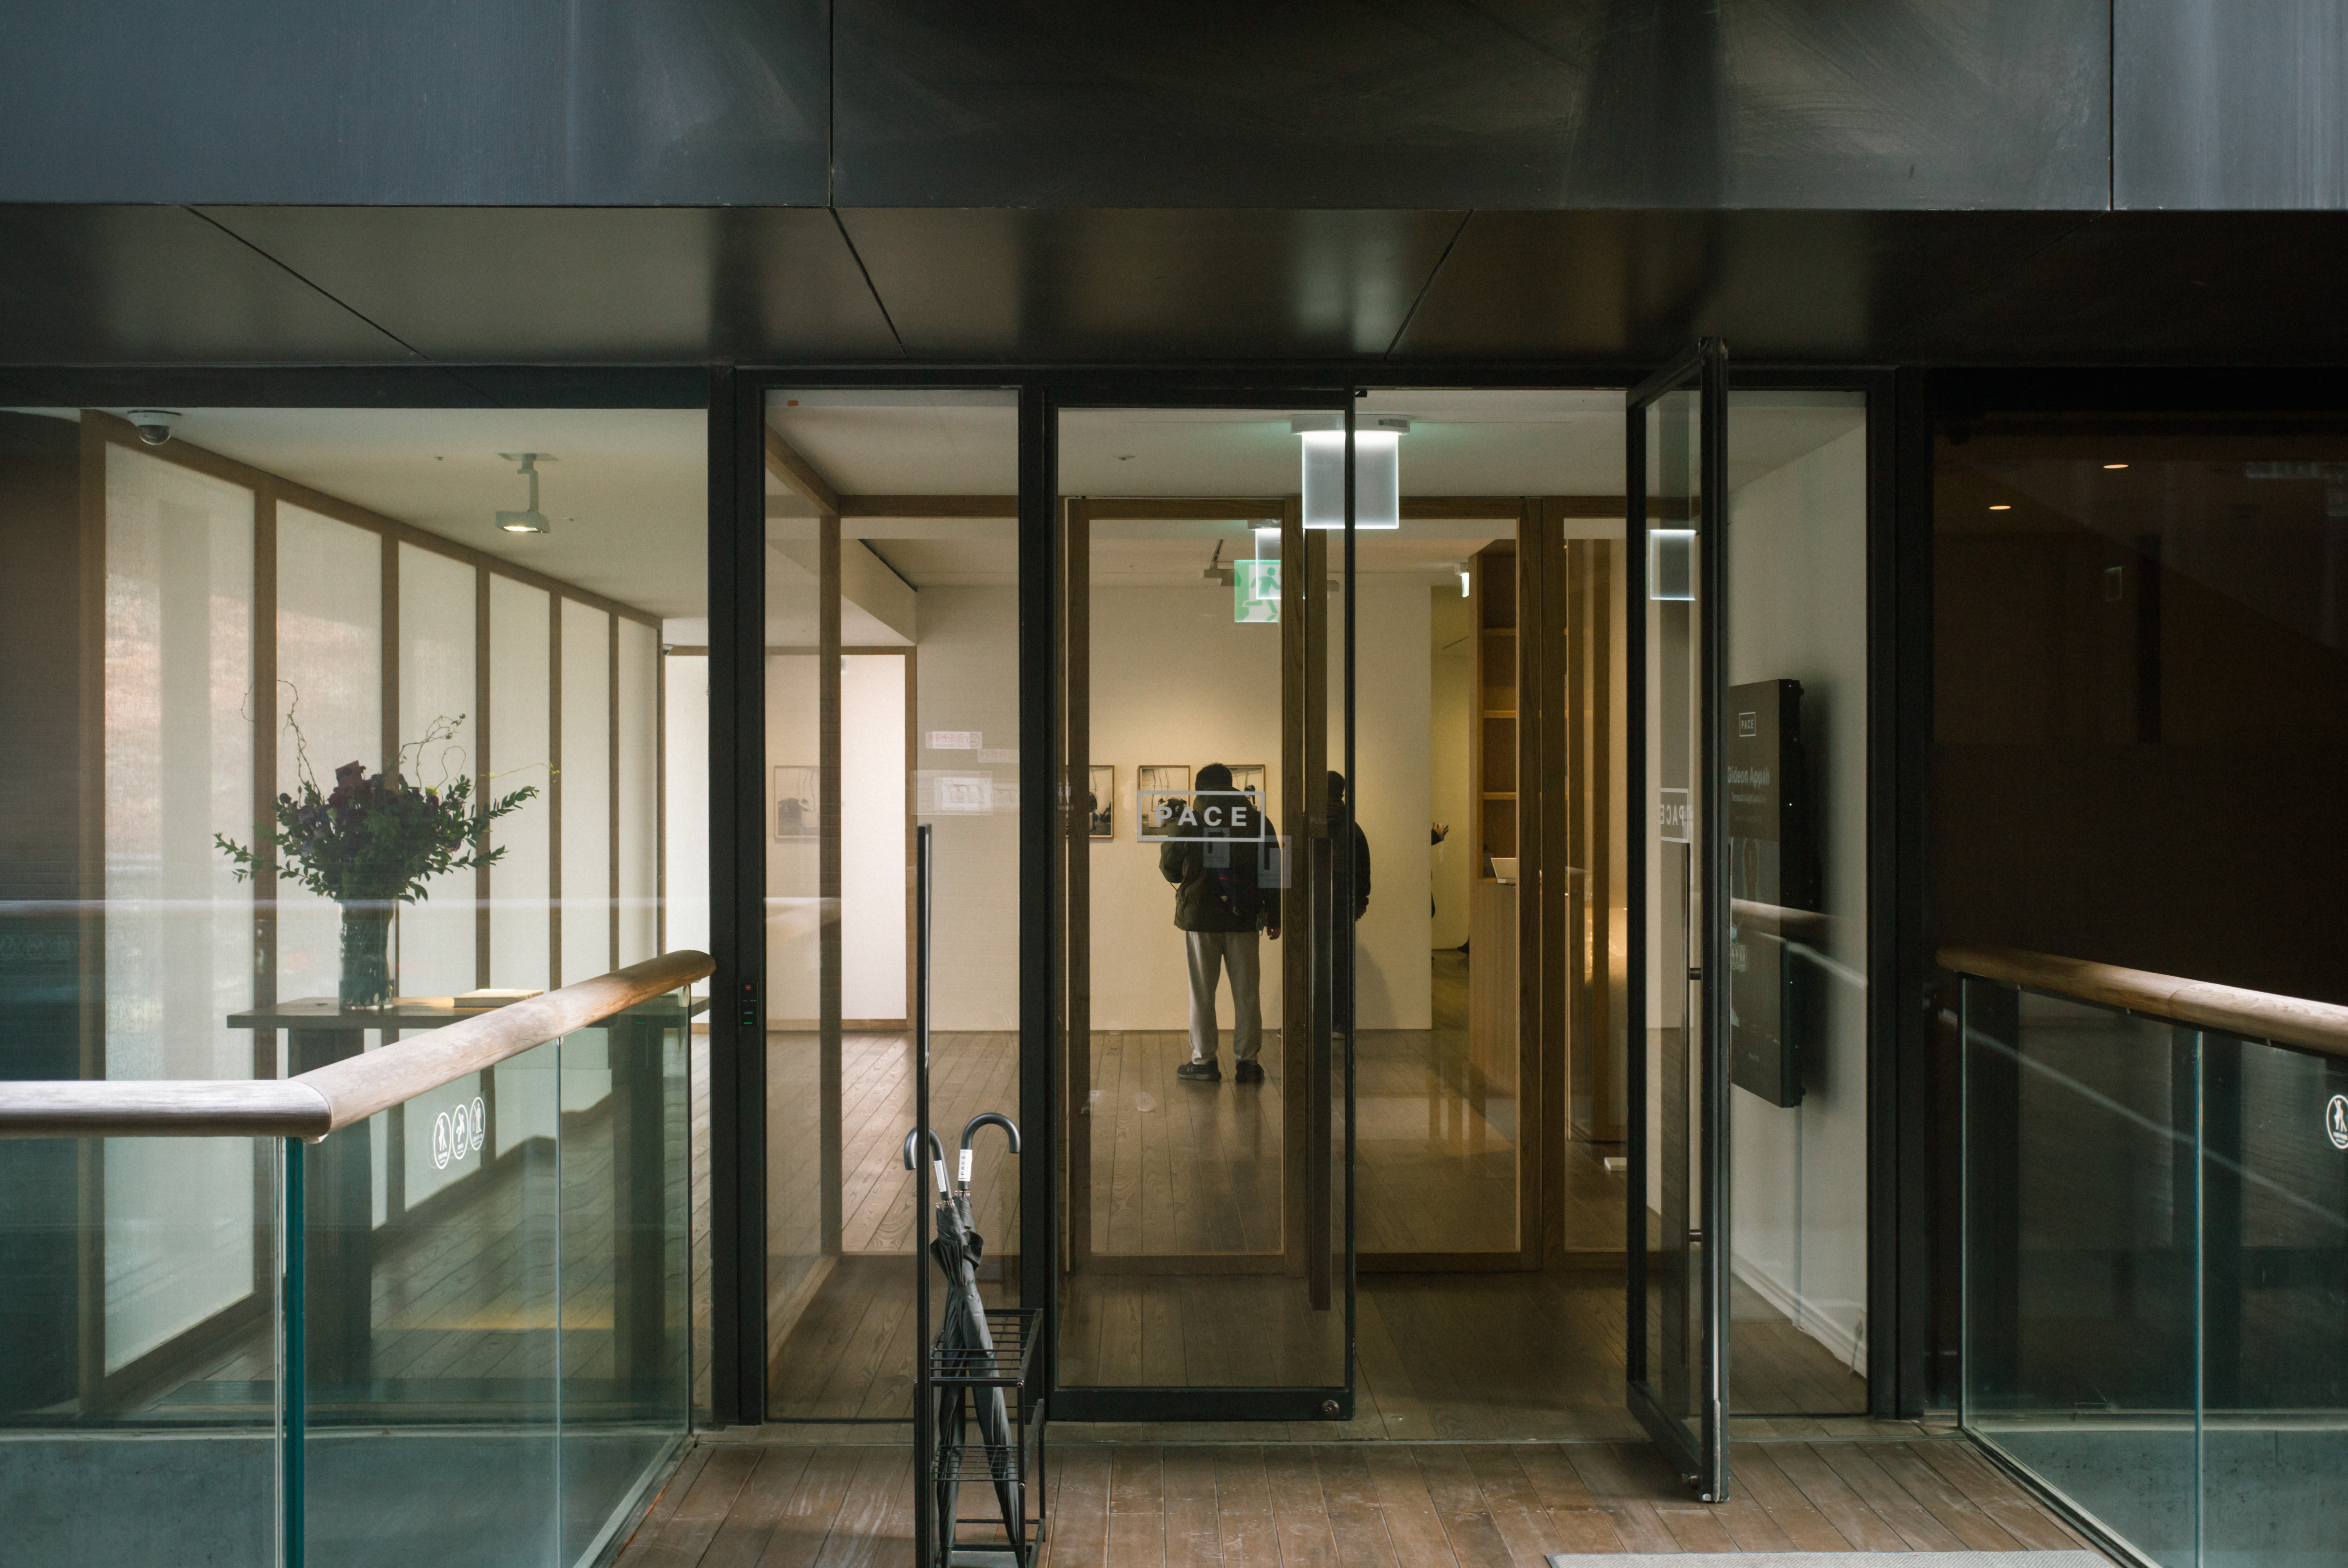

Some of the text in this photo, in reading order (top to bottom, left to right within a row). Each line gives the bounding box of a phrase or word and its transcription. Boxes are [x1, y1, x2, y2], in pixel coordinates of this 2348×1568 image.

[1741, 719, 1754, 730] PACE
[1727, 766, 1770, 788] Gideon Appah
[1155, 806, 1247, 826] PACE
